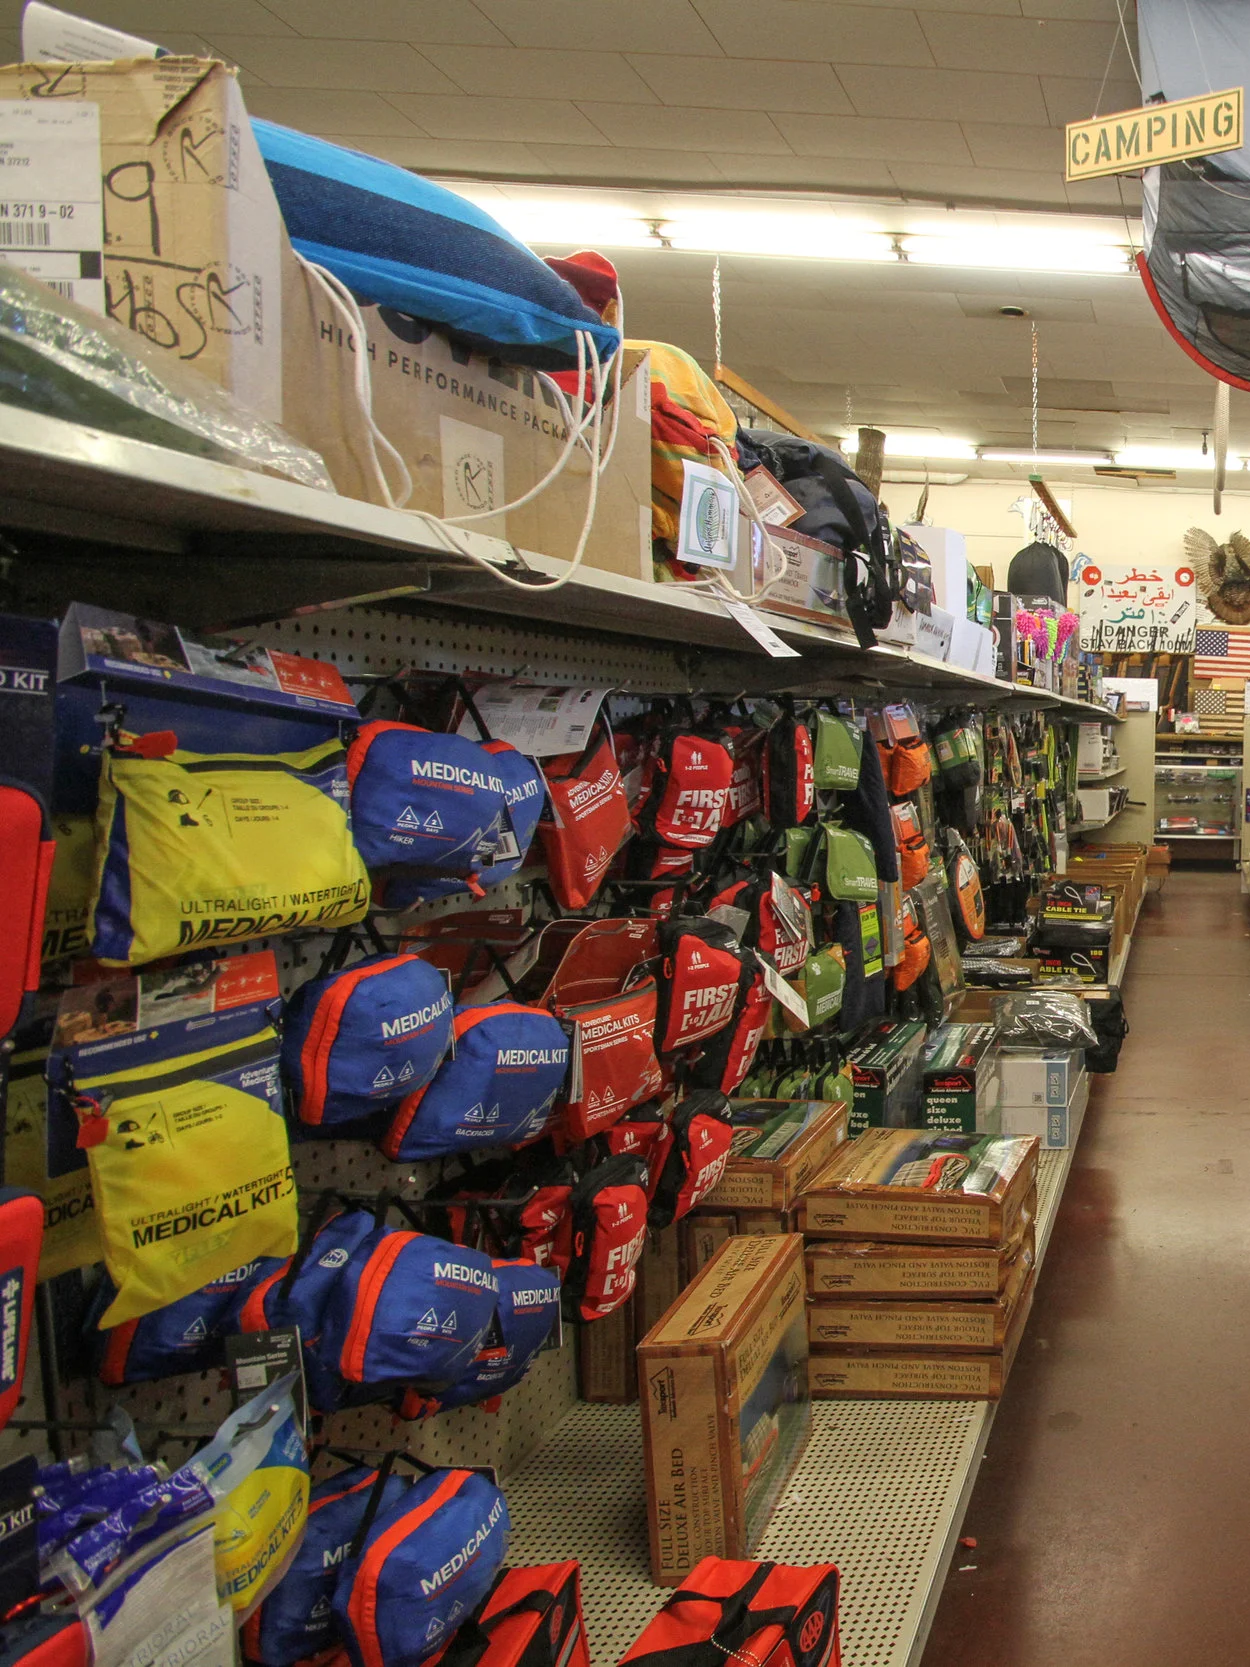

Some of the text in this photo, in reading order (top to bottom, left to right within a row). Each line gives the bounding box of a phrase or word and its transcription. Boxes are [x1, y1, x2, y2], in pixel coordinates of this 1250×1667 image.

[1071, 101, 1234, 166] CAMPING
[388, 349, 518, 424] PERFORMANCE
[1115, 568, 1164, 585] خطر
[1104, 625, 1169, 638] DANGER
[1081, 639, 1114, 649] STAY
[1116, 639, 1155, 650] BACK
[14, 671, 49, 690] KIT
[412, 760, 505, 794] MEDICAL KIT
[525, 779, 539, 797] KIT
[568, 769, 614, 809] MEDICAL KITS
[678, 788, 730, 808] FIRST
[389, 834, 415, 846] HIKER
[181, 896, 278, 915] ULTRALIGHT
[178, 910, 312, 947] MEDICAL
[683, 982, 739, 1010] FIRST
[381, 989, 452, 1038] MEDICAL KIT
[582, 1014, 612, 1029] ADVENTURE
[581, 1013, 640, 1041] MEDICAL KITS
[583, 1035, 628, 1055] SPORTSMAN SERIES
[497, 1048, 568, 1065] MEDICAL KIT
[927, 1096, 958, 1107] queen
[927, 1105, 947, 1115] size
[850, 1119, 870, 1129] bed
[927, 1115, 962, 1125] deluxe
[455, 1127, 495, 1137] BACKPACKER
[131, 1196, 211, 1228] ULTRALIGHT
[222, 1170, 285, 1201] WATERTIGHT
[870, 1203, 981, 1215] BOSTON AND PINCH
[133, 1199, 248, 1249] MEDICAL
[891, 1223, 958, 1233] CONSTRUCTION
[434, 1262, 491, 1291] MEDICAL
[900, 1280, 967, 1288] CONSTRUCTION
[512, 1288, 552, 1306] MEDICAL
[709, 1442, 718, 1473] PINCH
[671, 1447, 690, 1570] DELUXE AIR BED
[691, 1466, 701, 1542] CONSTRUCTION
[11, 1504, 34, 1529] KIT
[659, 1499, 674, 1571] FULL SIZE
[420, 1497, 504, 1596] MEDICAL KIT
